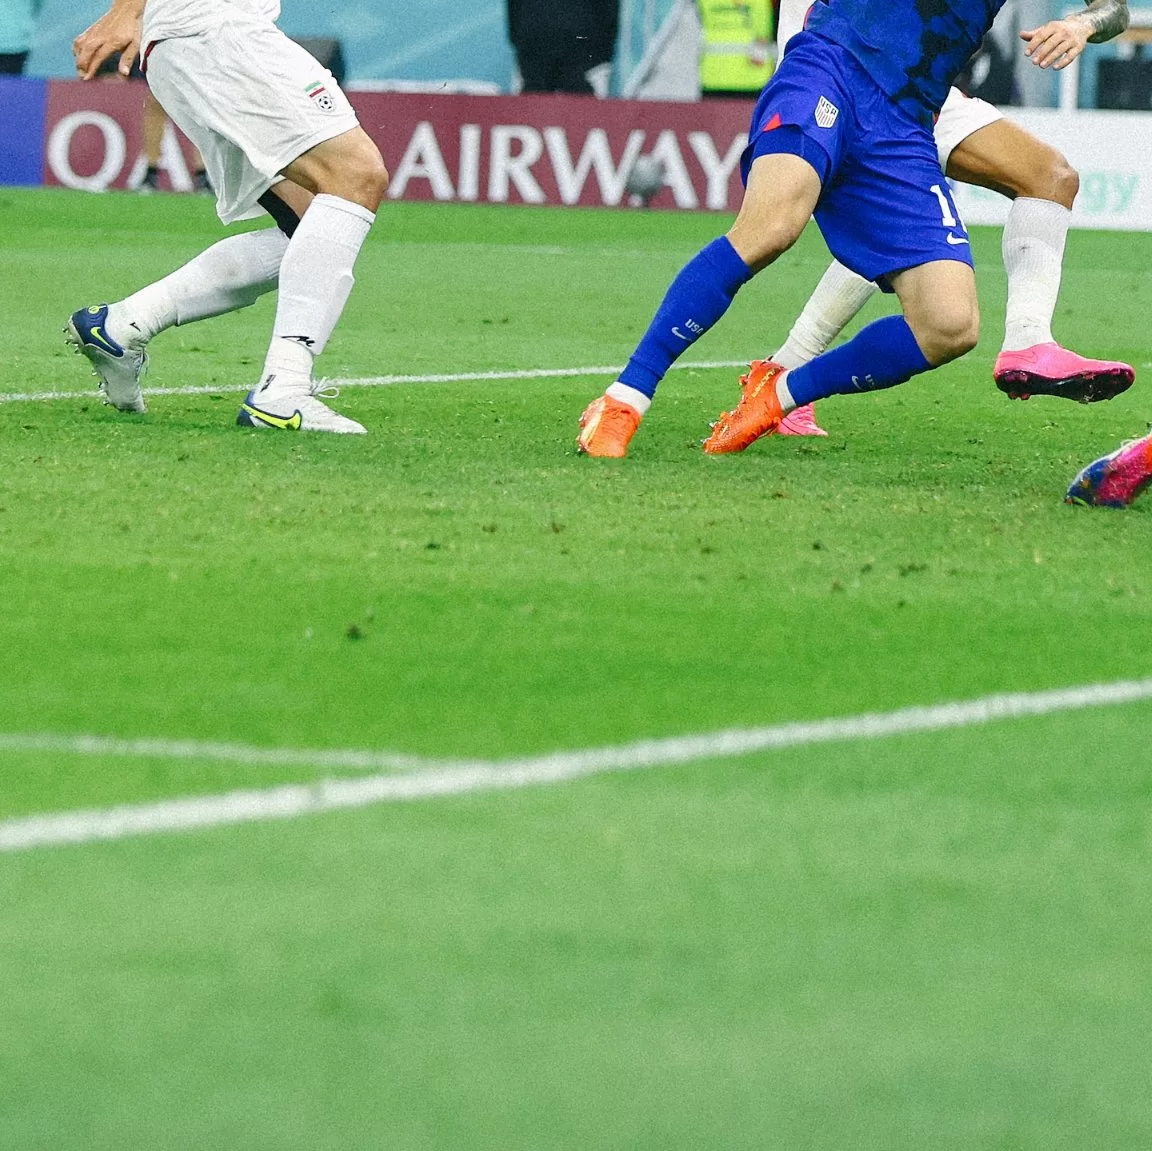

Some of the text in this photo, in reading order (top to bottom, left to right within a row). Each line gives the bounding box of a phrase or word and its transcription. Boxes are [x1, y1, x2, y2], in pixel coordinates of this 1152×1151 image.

[820, 100, 837, 116] USA
[386, 120, 750, 211] AIRWAY
[930, 184, 968, 233] 1
